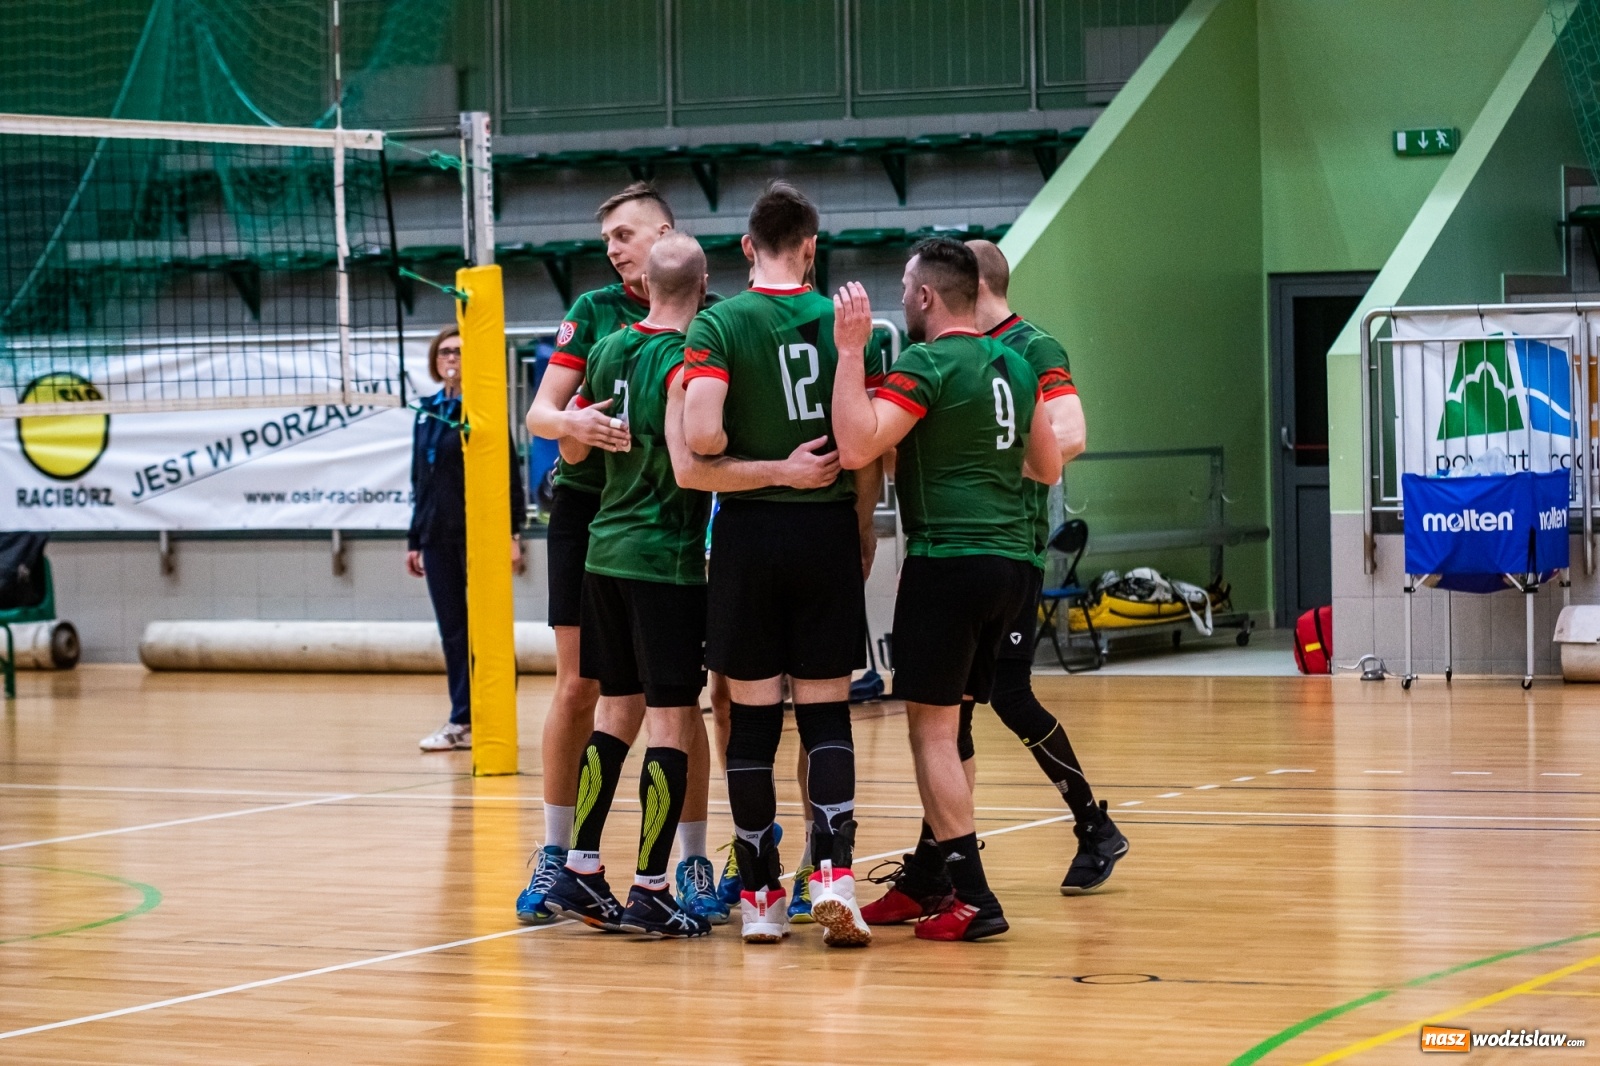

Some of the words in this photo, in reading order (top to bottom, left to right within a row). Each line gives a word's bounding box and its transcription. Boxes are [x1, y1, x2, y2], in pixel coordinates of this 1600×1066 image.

[778, 343, 825, 420] 12
[992, 377, 1015, 450] 9
[16, 484, 115, 508] RACIBÓRZ
[131, 450, 198, 498] JEST
[205, 437, 233, 468] W
[1422, 509, 1513, 532] molten
